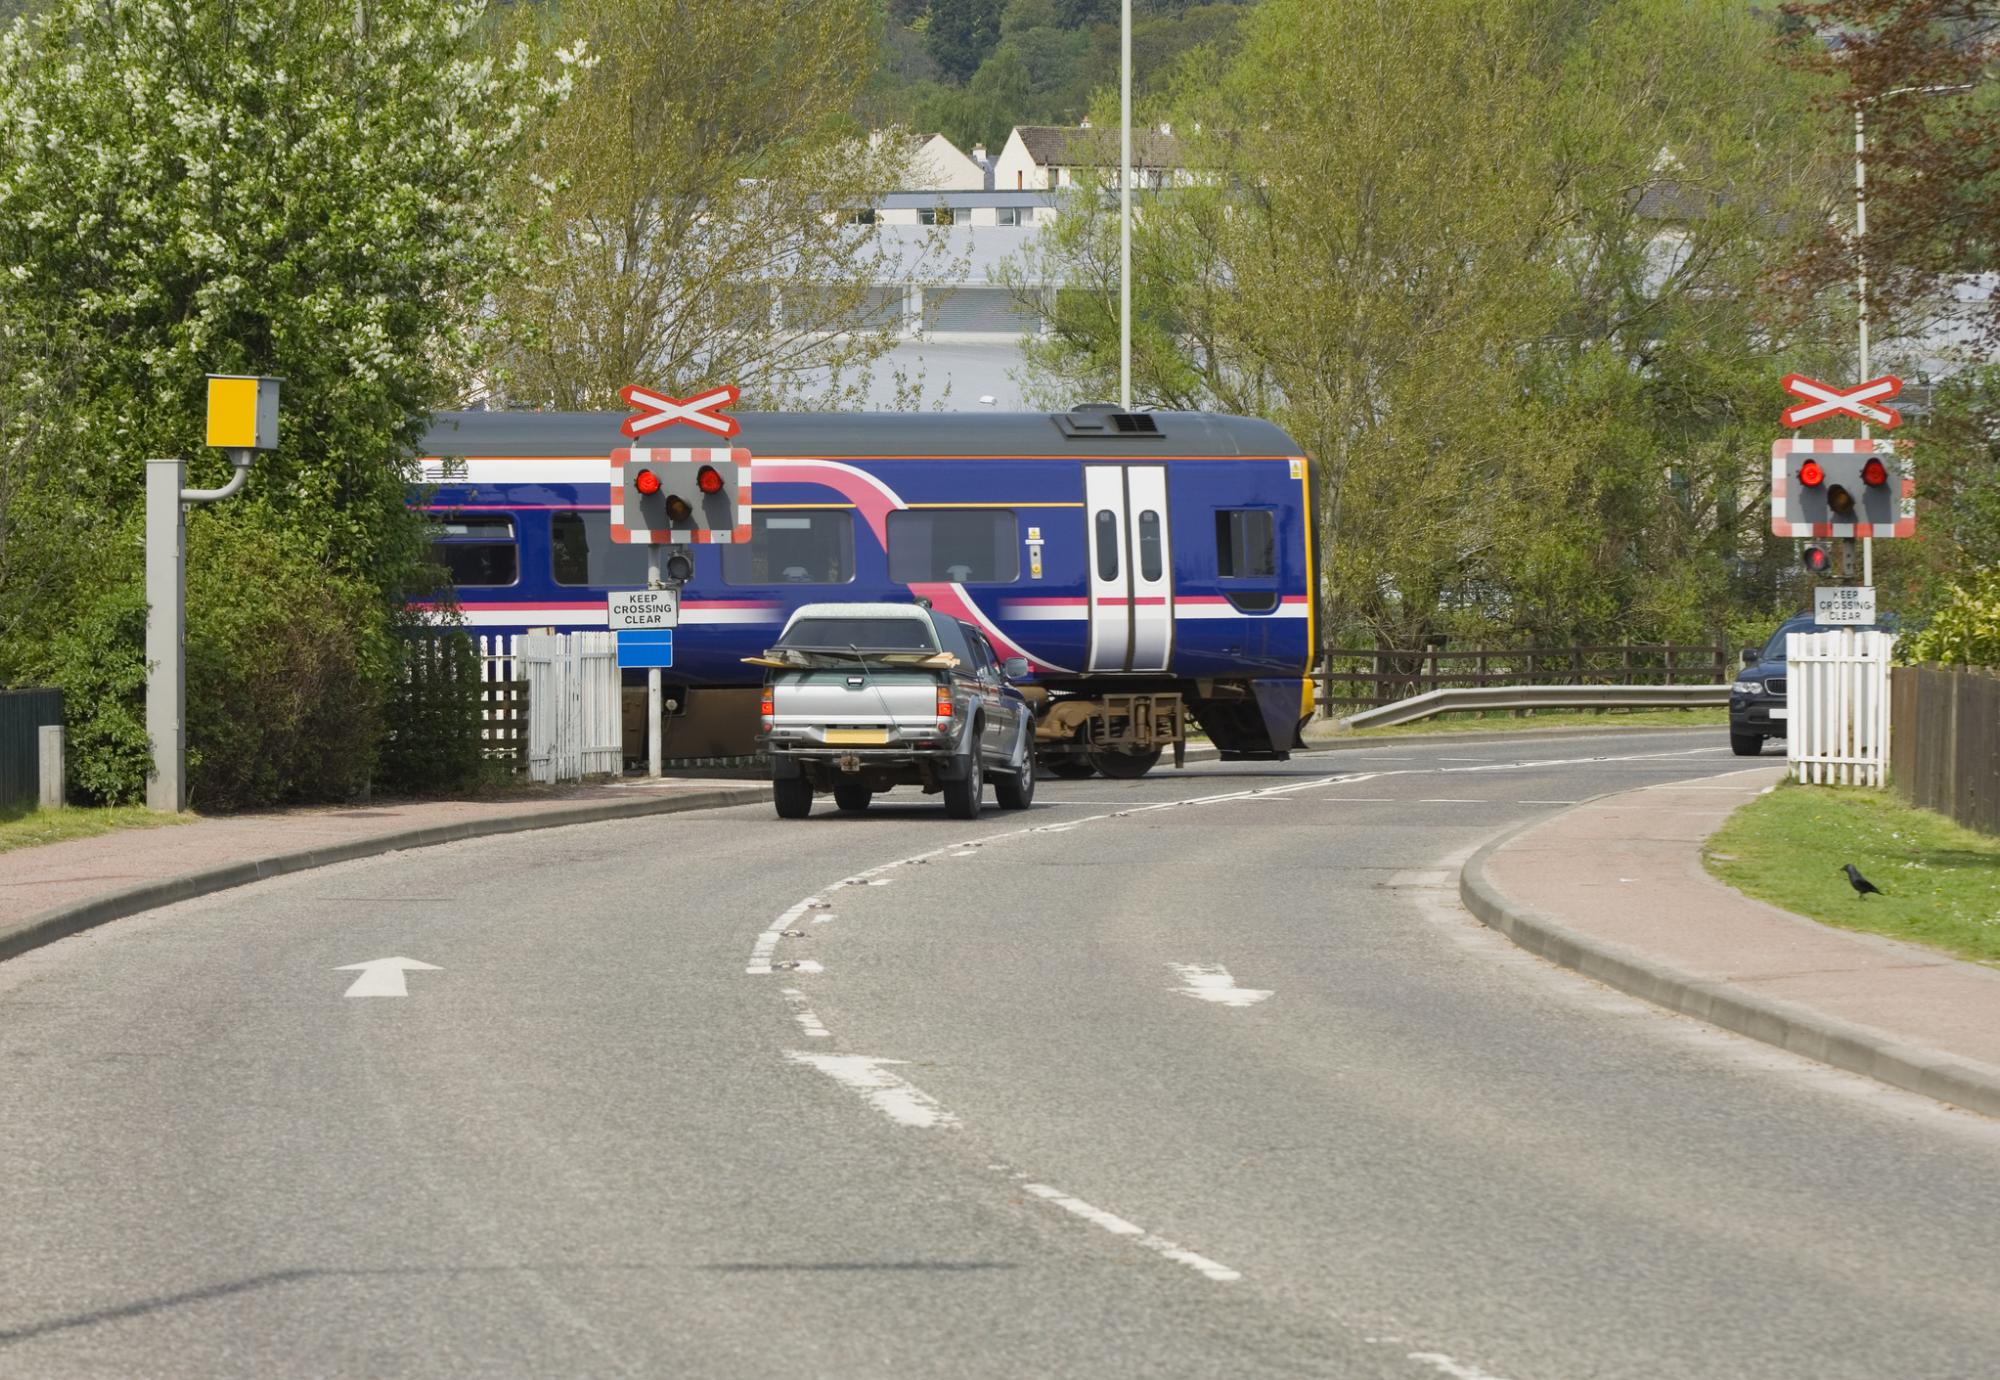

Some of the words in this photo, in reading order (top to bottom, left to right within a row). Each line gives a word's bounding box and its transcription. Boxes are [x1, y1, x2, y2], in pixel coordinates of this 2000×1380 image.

[629, 594, 658, 603] KEEP
[1832, 590, 1858, 599] KEEP
[613, 604, 672, 614] CROSSING
[625, 614, 661, 624] CLEAR
